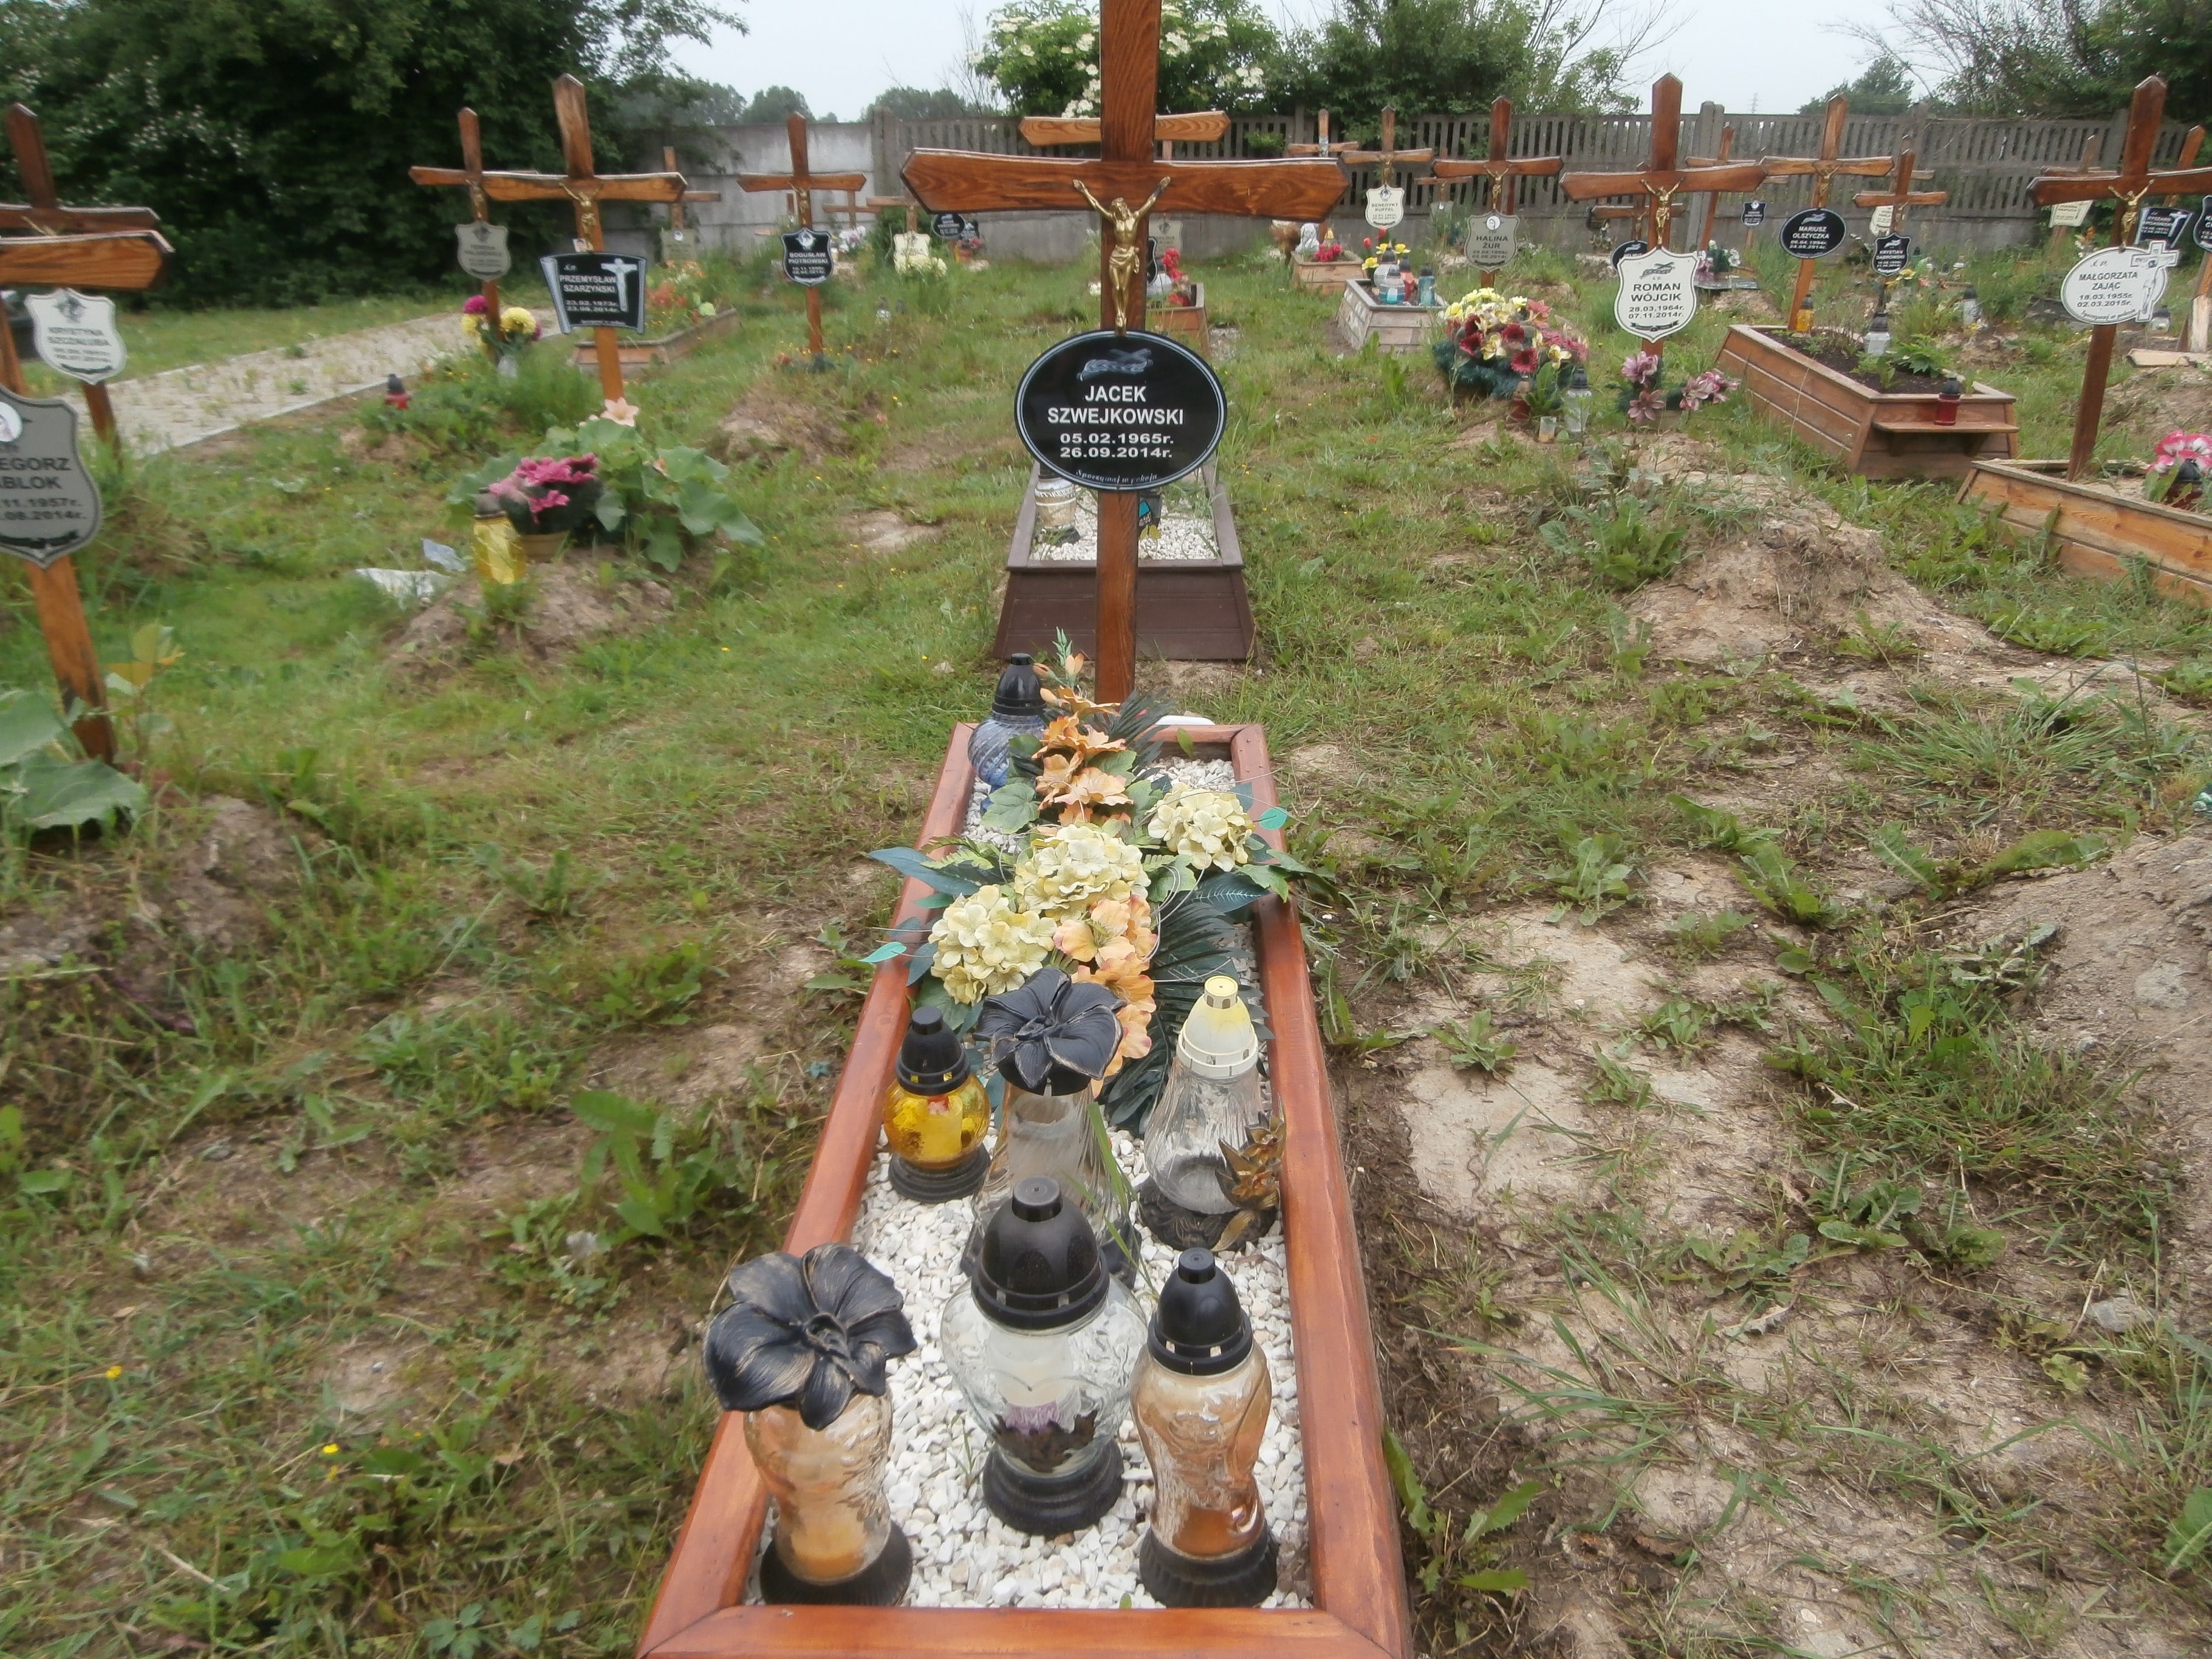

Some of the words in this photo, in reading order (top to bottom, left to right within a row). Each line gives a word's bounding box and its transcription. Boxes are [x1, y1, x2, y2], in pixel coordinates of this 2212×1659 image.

[559, 274, 616, 284] PRZEMYSŁAW
[2079, 272, 2138, 281] MAŁGORZATA
[563, 283, 615, 293] SZARZYŃSKI
[1633, 283, 1681, 292] ROMAN
[2092, 281, 2121, 291] ZAJĄC
[1631, 293, 1682, 302] WÓJCIK
[1084, 386, 1147, 402] JACEK
[1047, 407, 1184, 425] SZWEJKOWSKI
[1060, 433, 1174, 445] 05.02.1965r.
[1060, 447, 1173, 459] 26.09.2014r.
